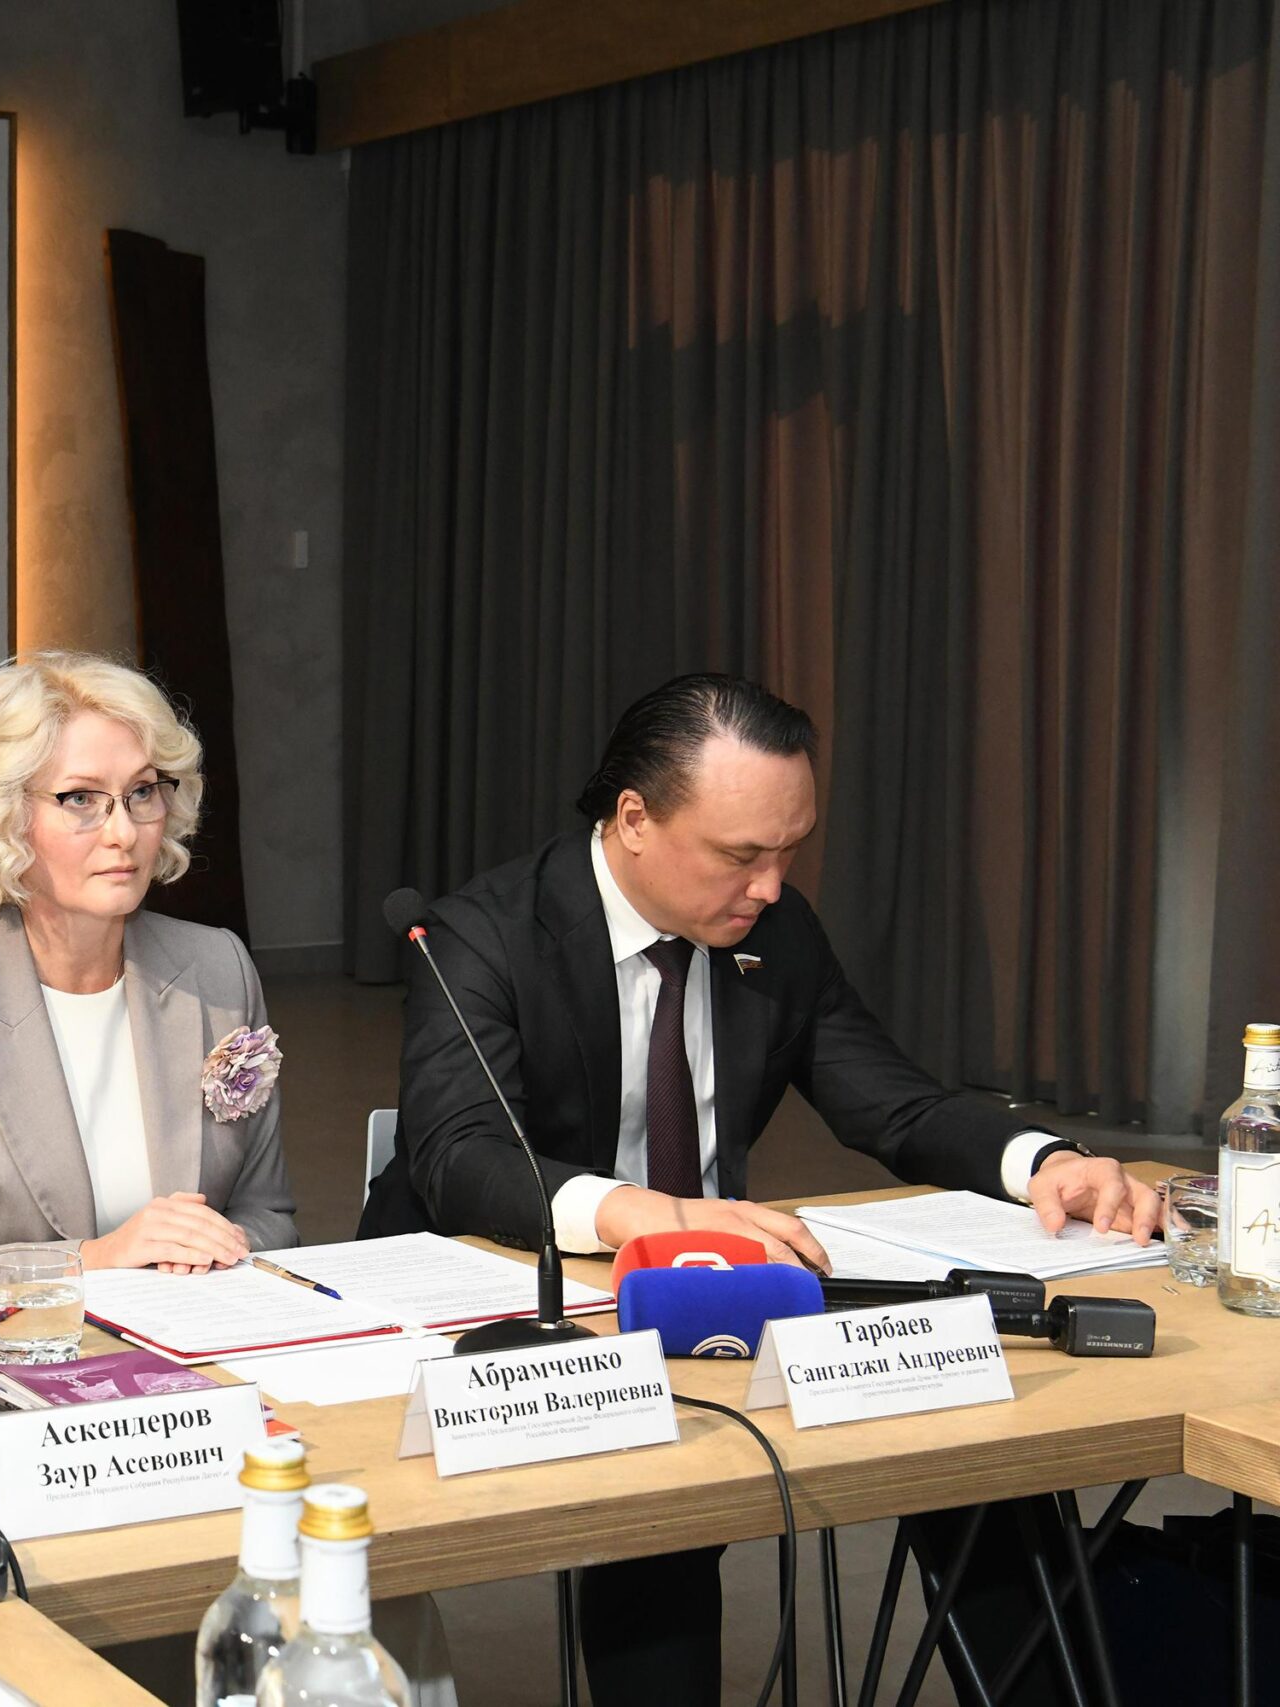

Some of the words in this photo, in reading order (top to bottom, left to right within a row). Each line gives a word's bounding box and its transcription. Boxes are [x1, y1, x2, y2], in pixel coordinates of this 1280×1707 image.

[835, 1315, 933, 1347] Тарбаев
[467, 1352, 622, 1392] Абрамченко
[787, 1358, 890, 1385] Сангаджи
[897, 1343, 1001, 1371] Андреевич
[433, 1400, 539, 1429] Виктория
[544, 1381, 664, 1413] Валериевна
[41, 1408, 212, 1448] Аскендеров
[37, 1461, 98, 1490] Заур
[106, 1445, 224, 1478] Асевович
